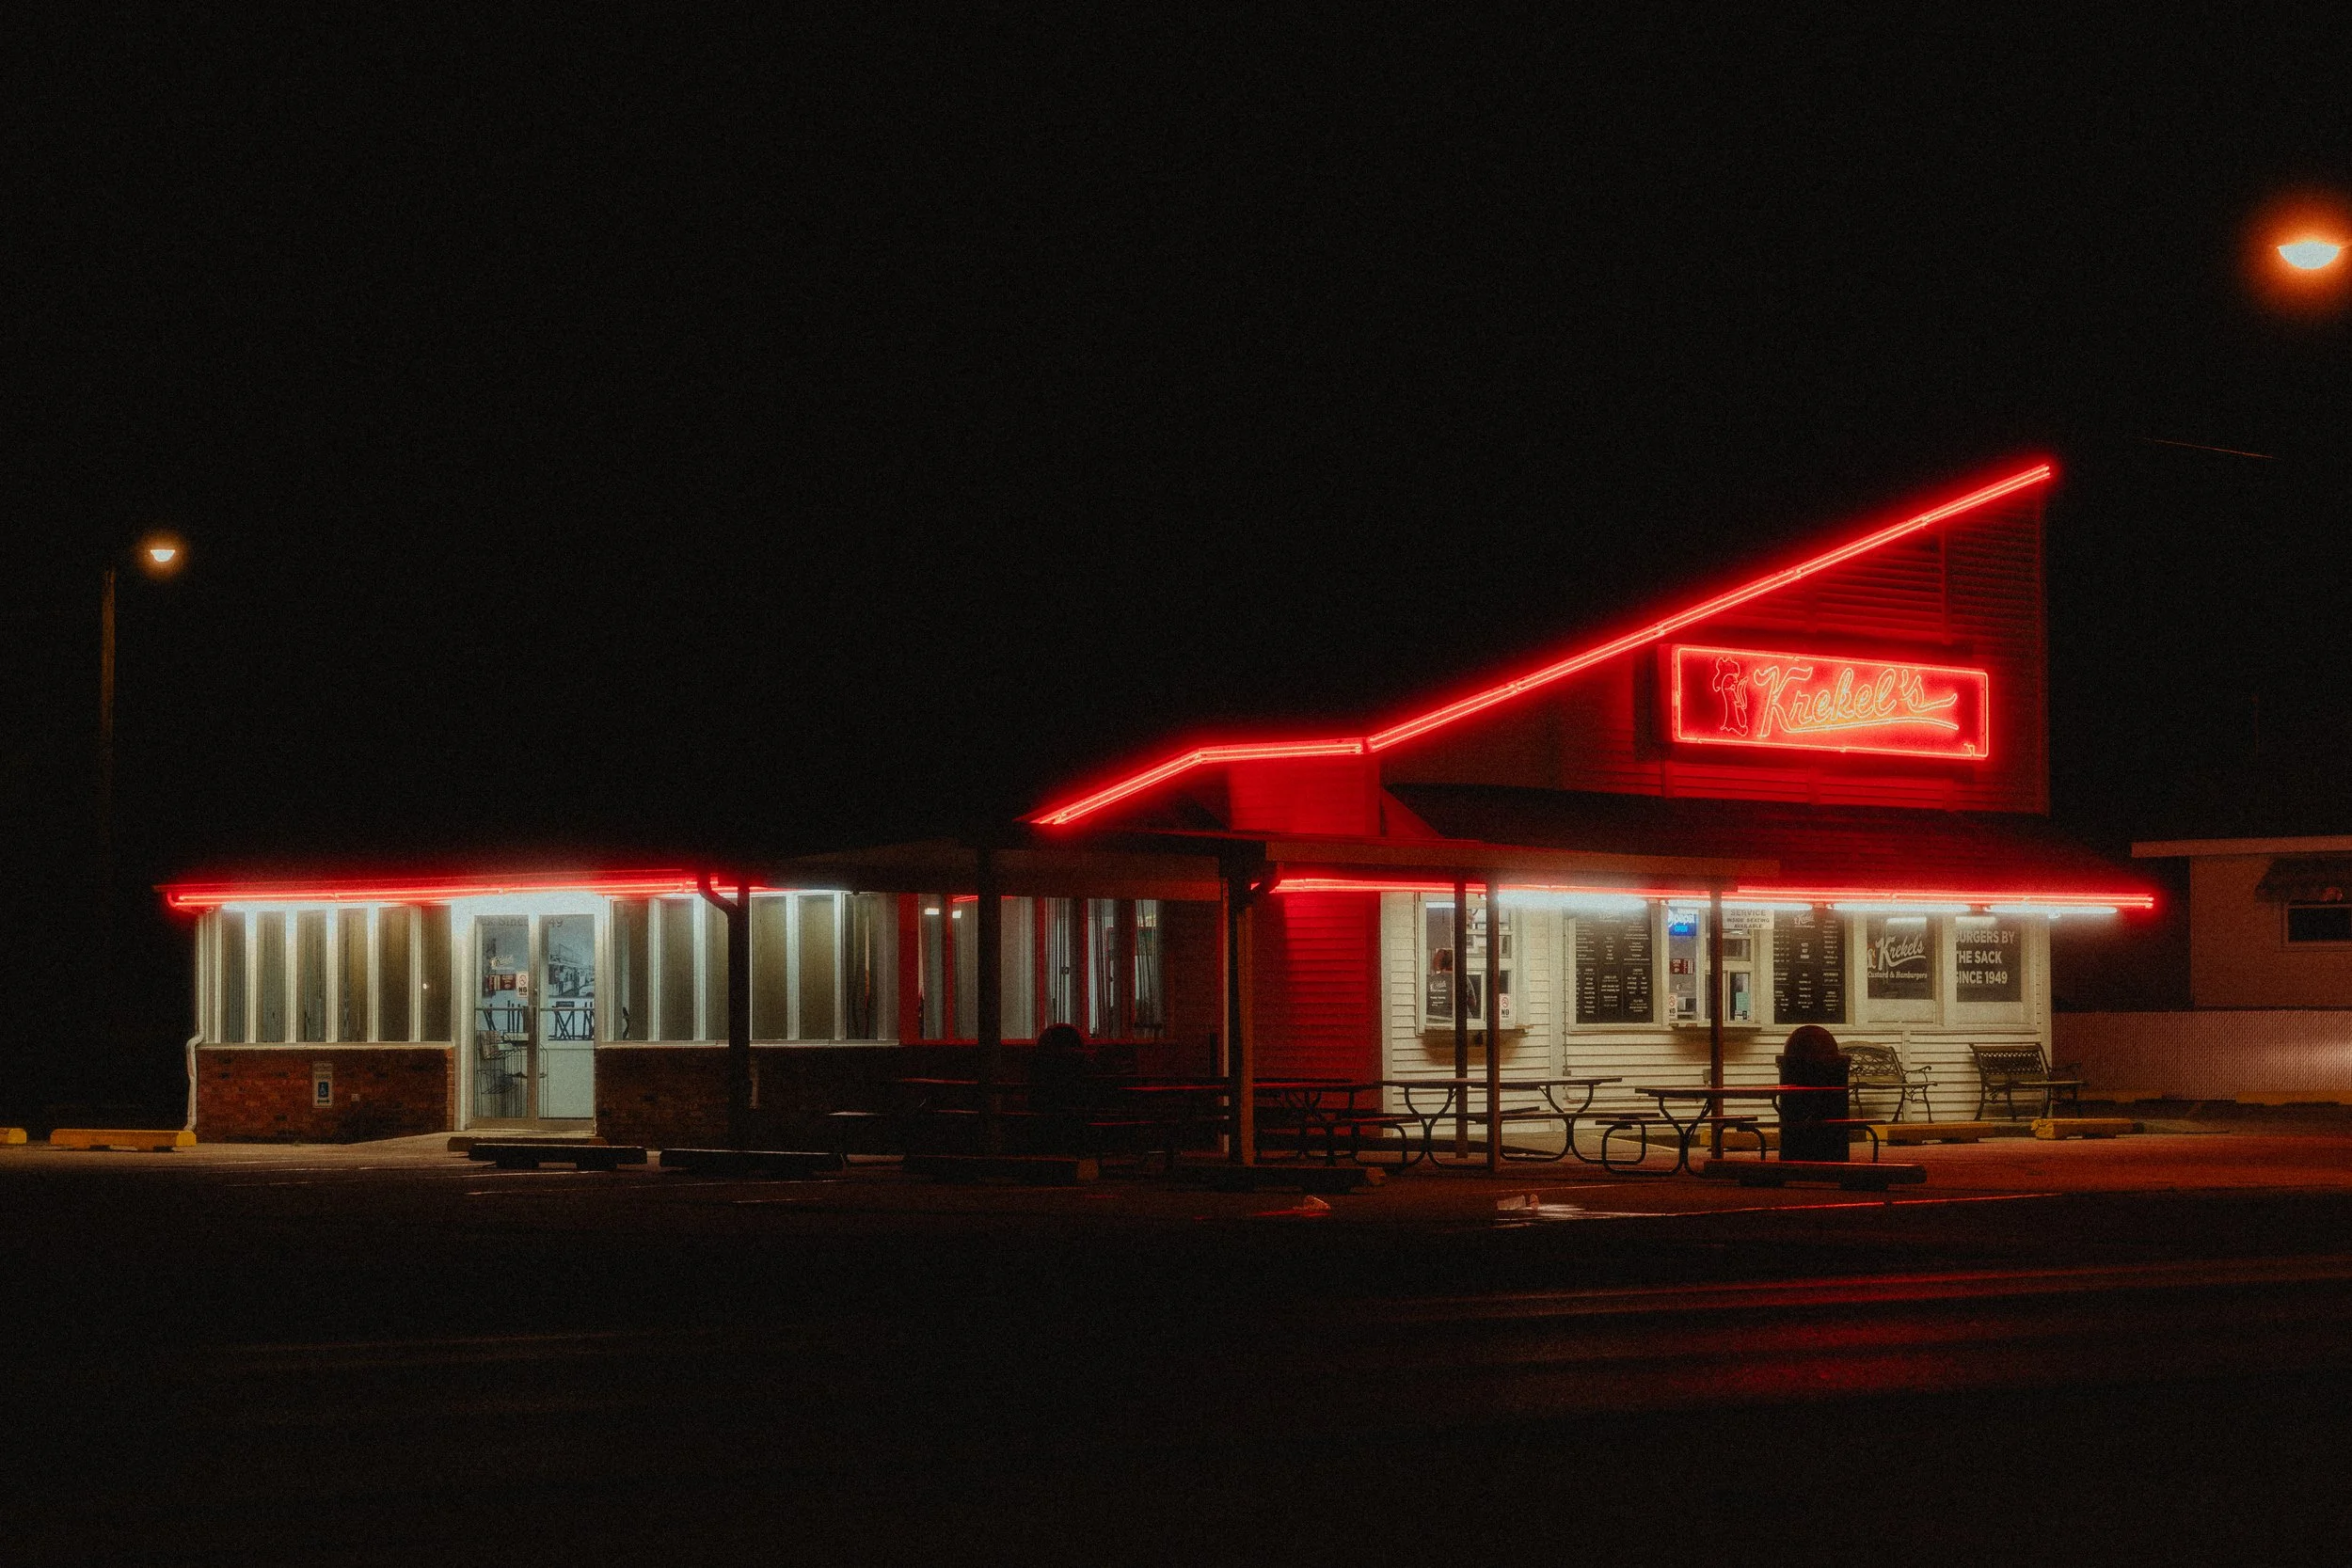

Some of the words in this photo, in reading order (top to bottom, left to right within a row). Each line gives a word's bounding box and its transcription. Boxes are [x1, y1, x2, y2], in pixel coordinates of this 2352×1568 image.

[1754, 665, 1958, 738] Krekel's
[2001, 930, 2014, 943] BY
[1974, 950, 2002, 964] SACK
[1896, 971, 1928, 980] Hamburgers
[1984, 971, 2008, 985] 1949
